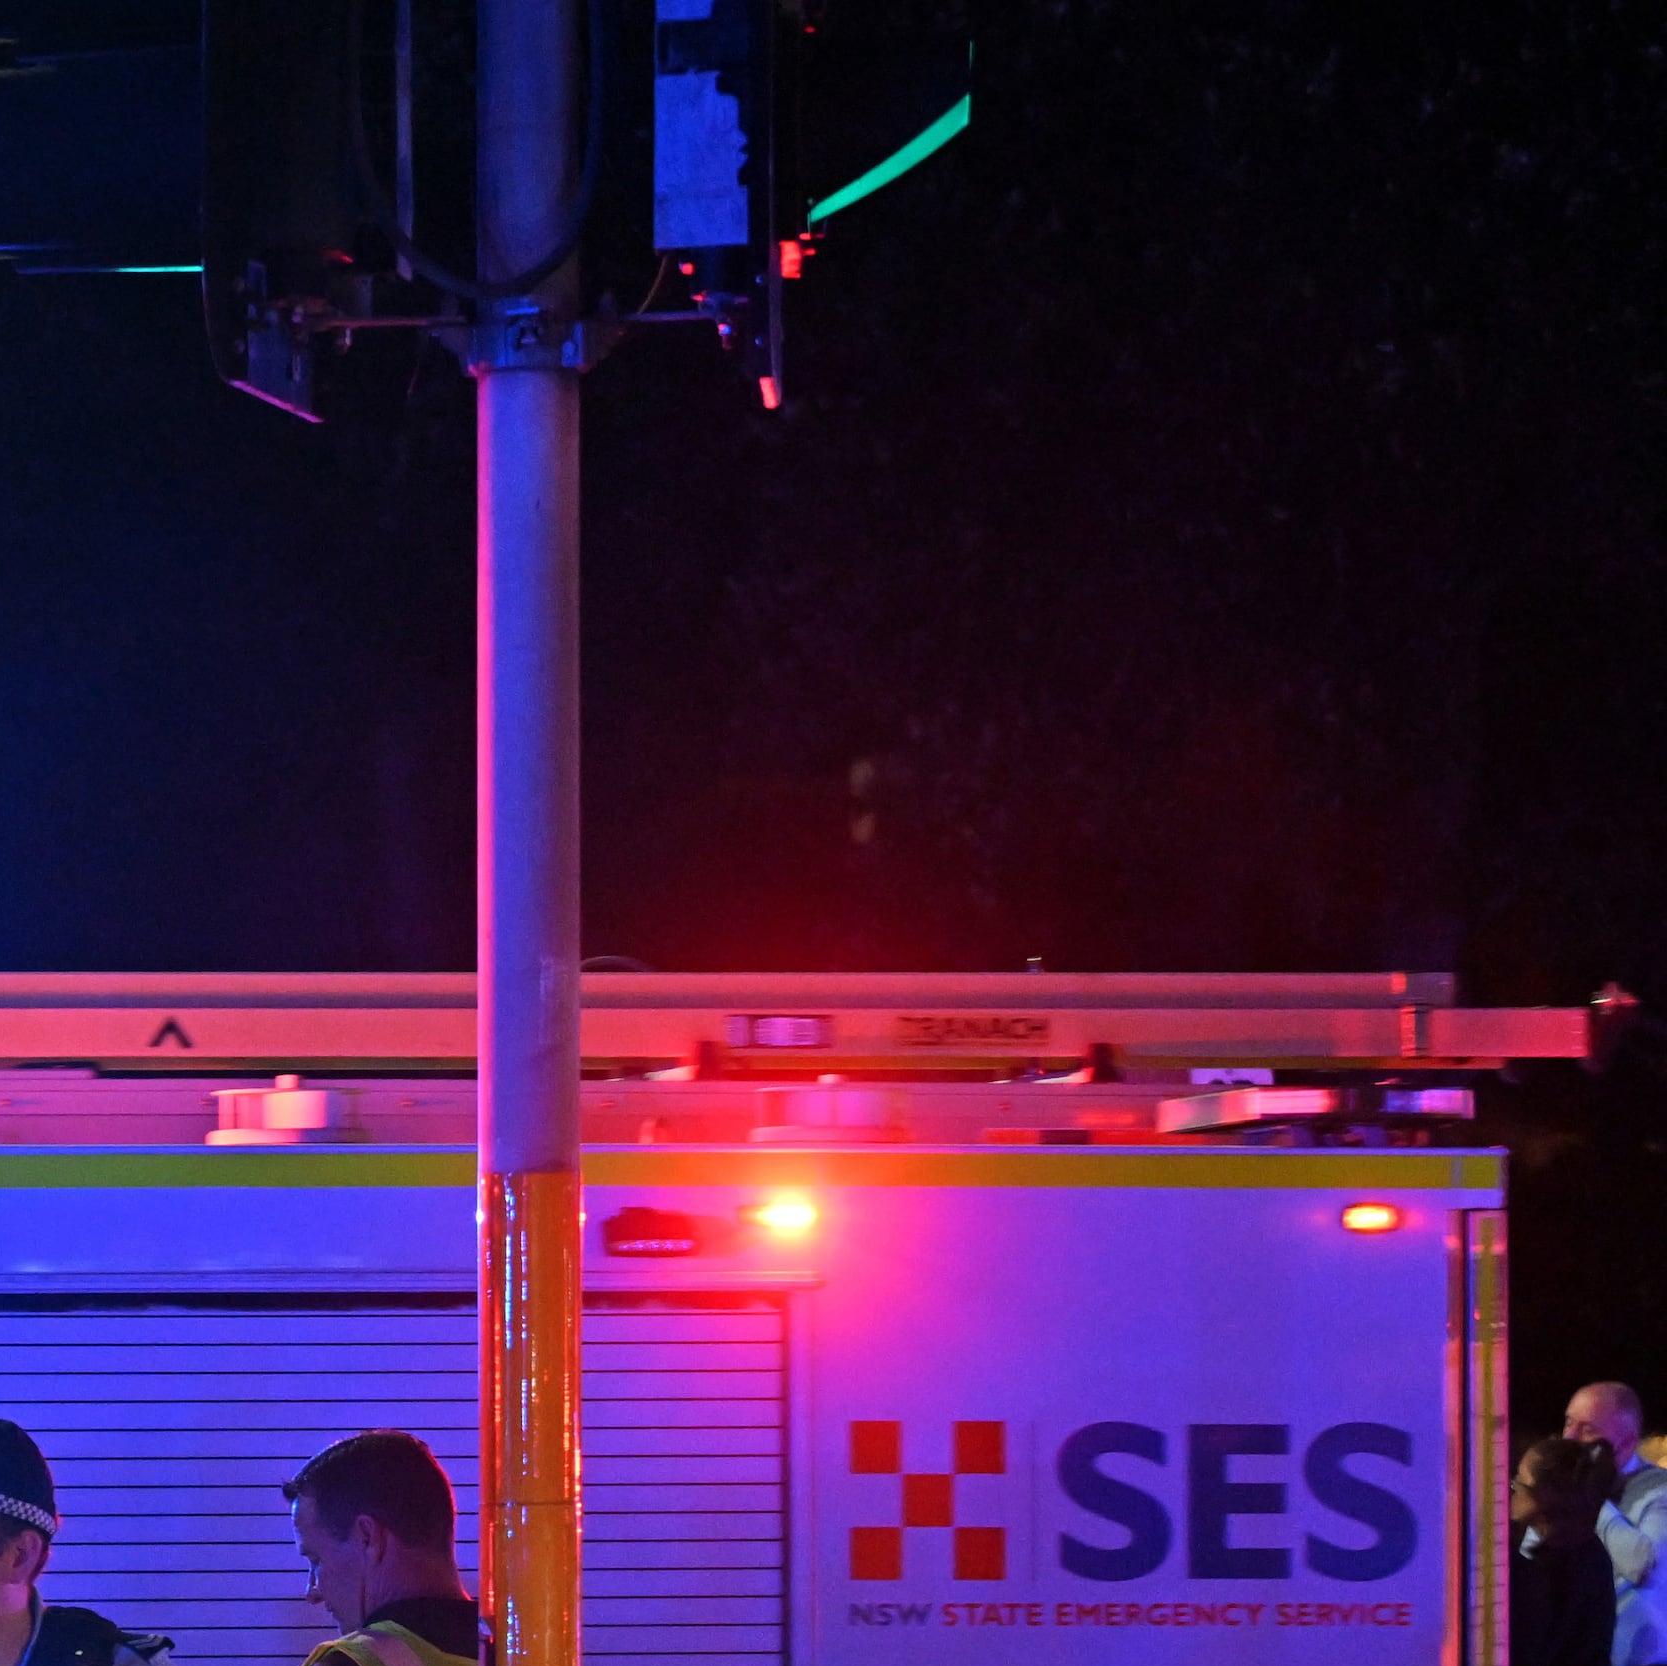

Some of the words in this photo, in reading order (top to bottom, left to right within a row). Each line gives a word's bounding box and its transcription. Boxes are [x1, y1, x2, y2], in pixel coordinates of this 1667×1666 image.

[1055, 1421, 1419, 1582] SES
[850, 1603, 932, 1627] NSW
[942, 1603, 1042, 1627] STATE
[1054, 1603, 1265, 1627] EMERGENCY
[1276, 1603, 1412, 1627] SERVICE
